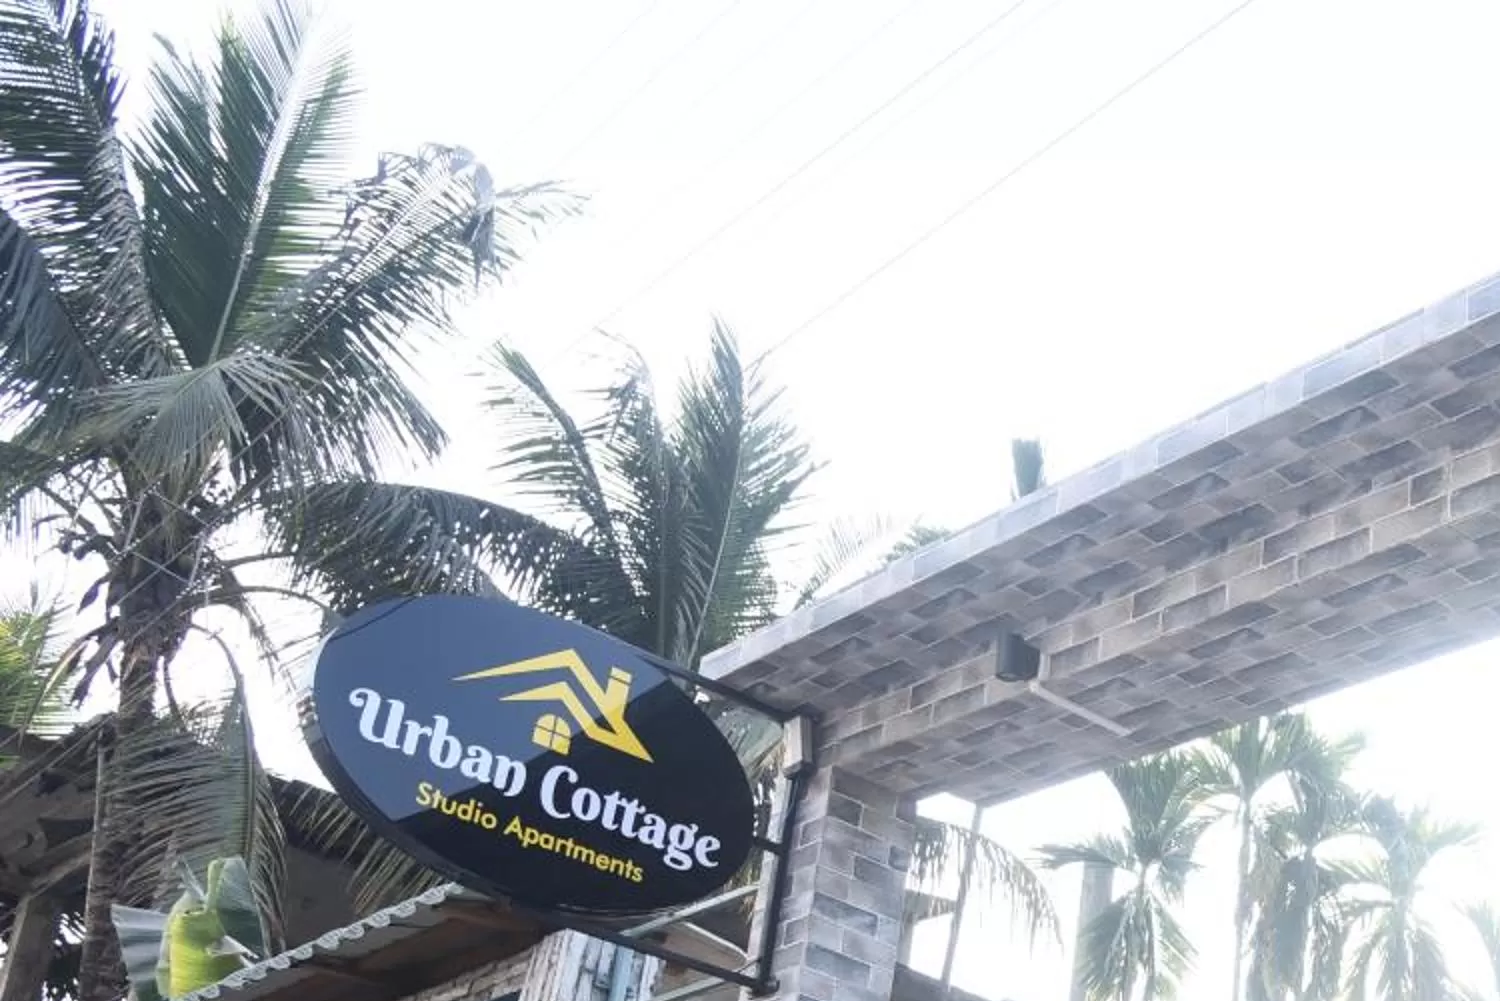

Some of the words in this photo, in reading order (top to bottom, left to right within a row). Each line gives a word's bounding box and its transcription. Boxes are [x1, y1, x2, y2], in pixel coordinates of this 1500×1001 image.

[349, 687, 528, 797] Urban
[539, 764, 721, 872] Cottage
[415, 781, 498, 830] Studio
[503, 815, 644, 883] Apartments
